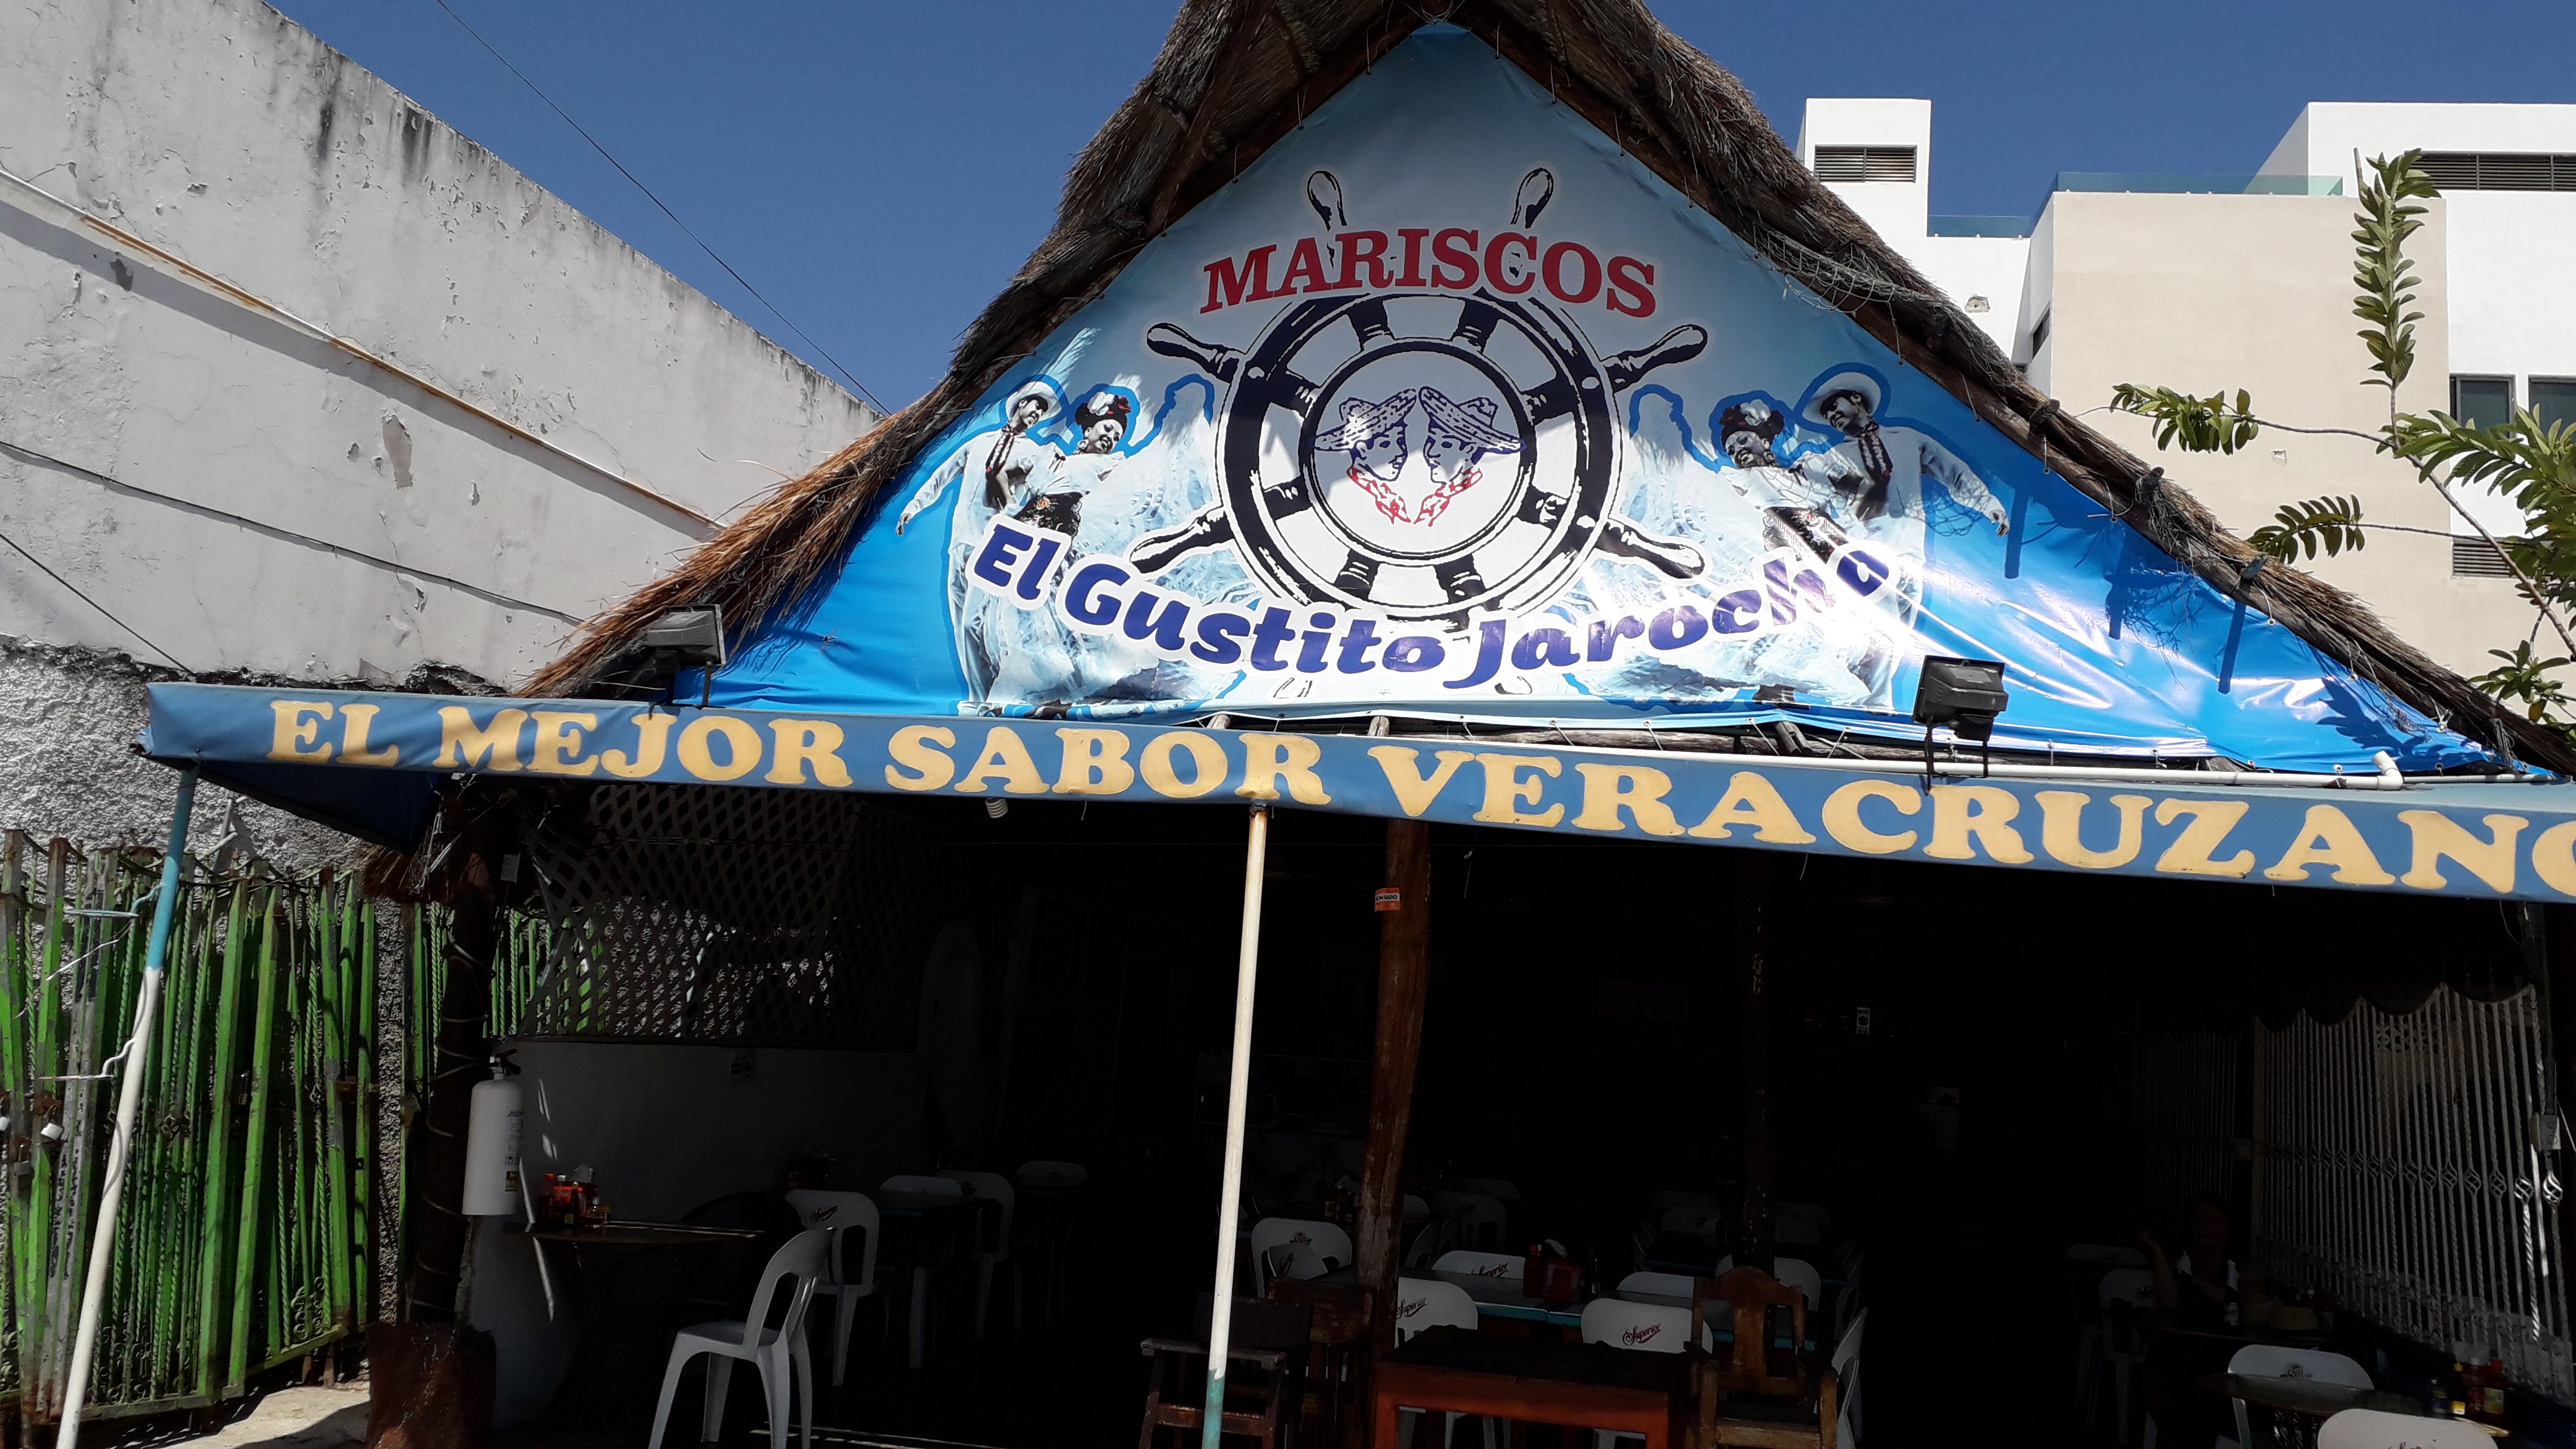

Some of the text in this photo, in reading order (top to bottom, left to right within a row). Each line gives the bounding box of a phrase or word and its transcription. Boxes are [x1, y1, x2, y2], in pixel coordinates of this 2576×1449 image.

[1199, 227, 1657, 318] MARISCOS
[973, 523, 1060, 601] El
[1065, 563, 1446, 674] Gustito
[267, 700, 399, 767] EL
[432, 705, 855, 788] MEJOR
[884, 725, 1332, 805] SABOR
